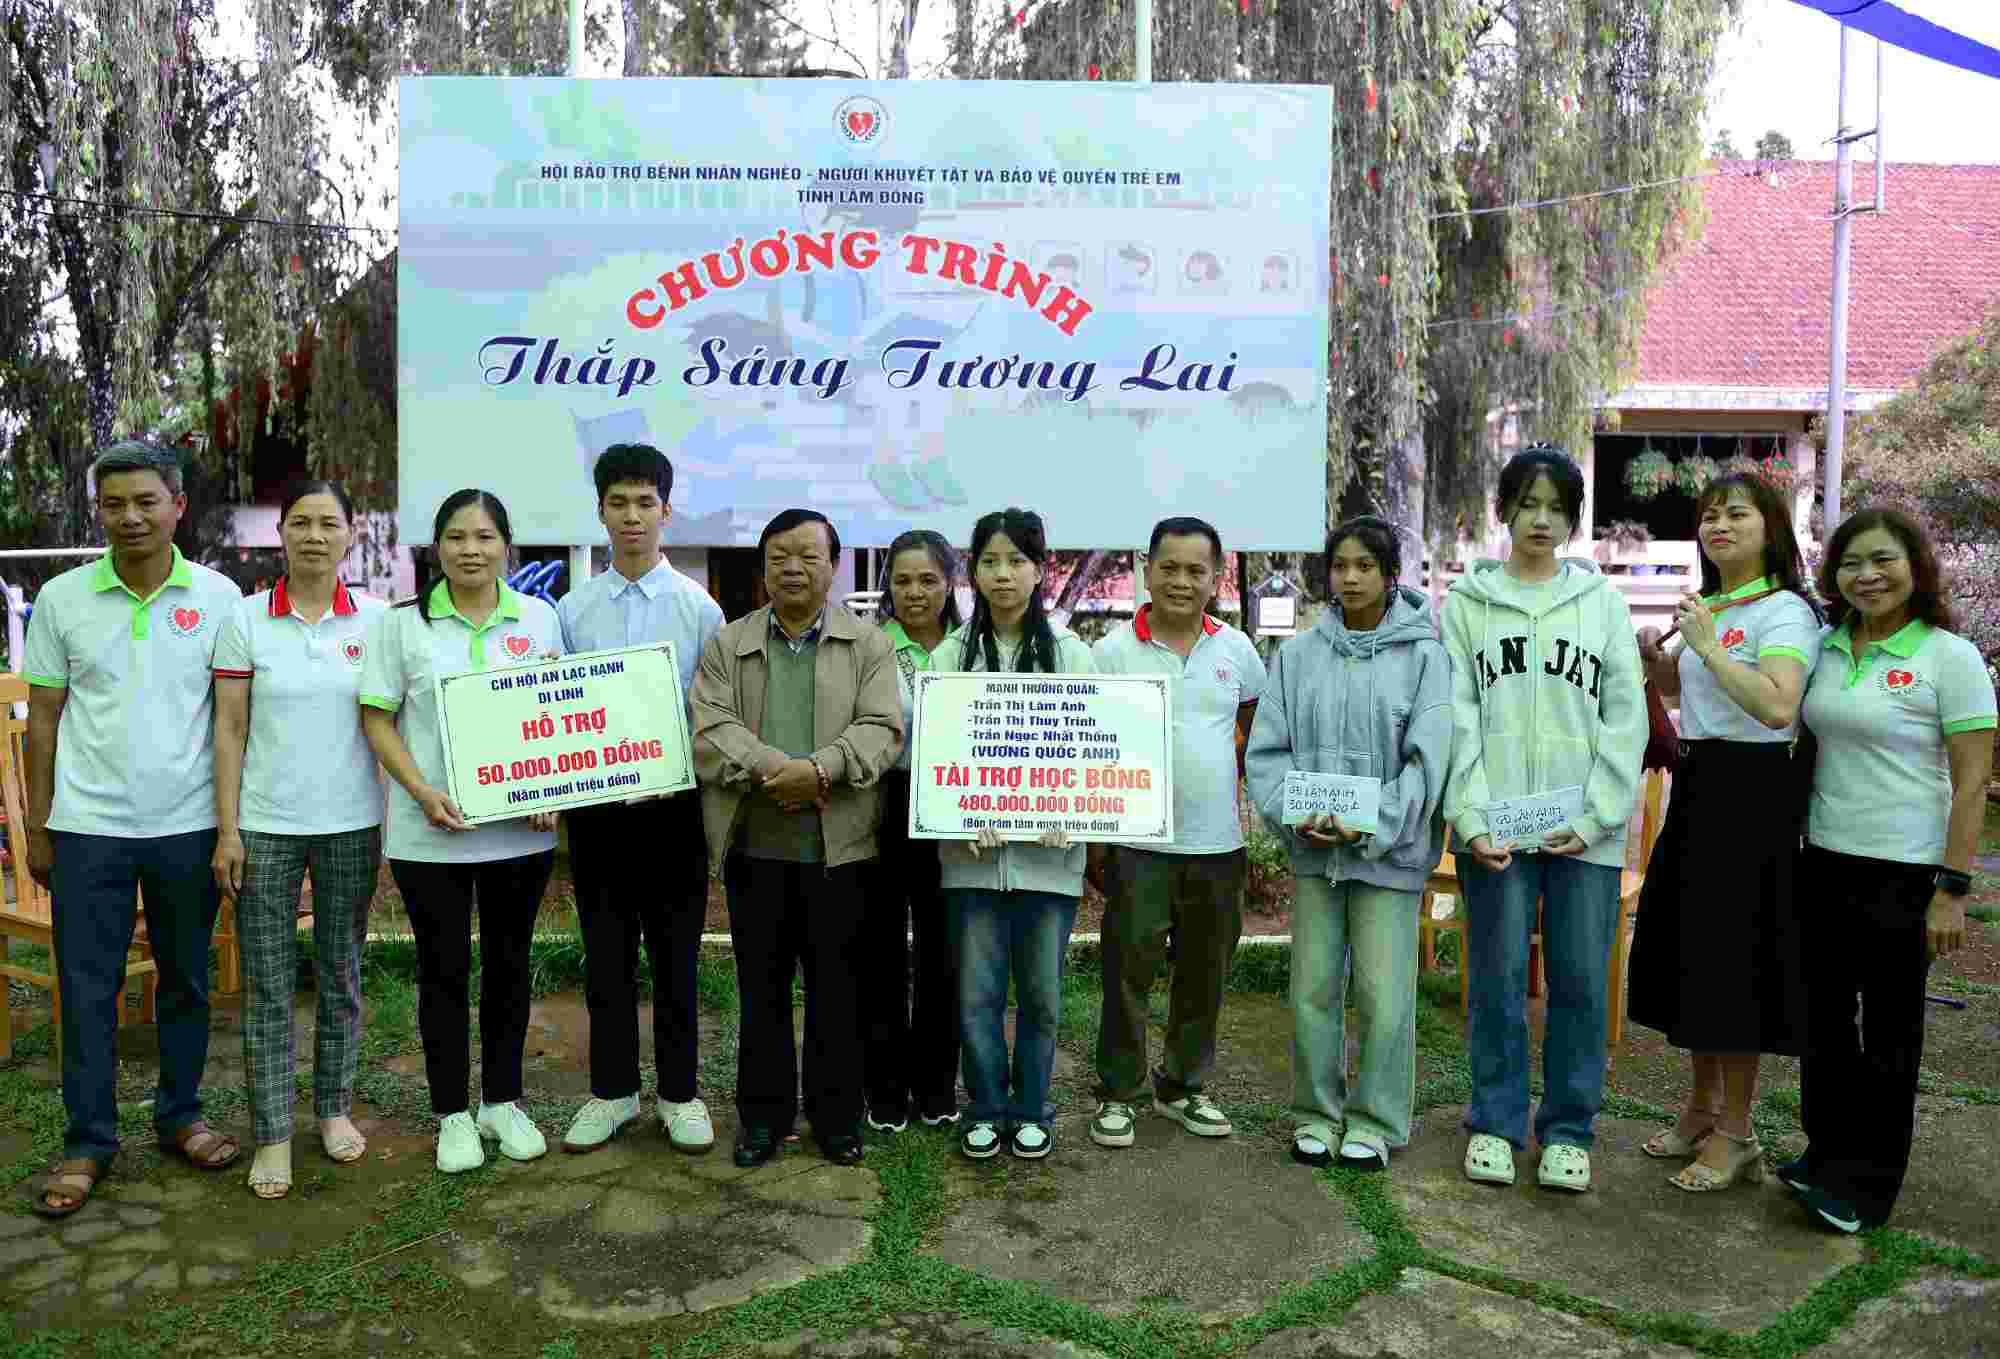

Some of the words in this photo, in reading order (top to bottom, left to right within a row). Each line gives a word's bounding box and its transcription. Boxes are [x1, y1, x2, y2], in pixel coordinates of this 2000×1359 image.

[1156, 171, 1181, 185] EM
[625, 229, 880, 329] CHƯƠNG
[902, 234, 1093, 337] TRÌNH
[479, 336, 660, 398] Thắp
[683, 337, 854, 399] Sáng
[882, 338, 1101, 401] Tương
[1119, 343, 1241, 392] Lai
[490, 675, 513, 691] CHI
[542, 670, 560, 683] AN
[538, 690, 551, 705] DI
[555, 687, 584, 702] LINH
[1061, 701, 1086, 713] Anh
[561, 707, 607, 735] TRỢ
[477, 749, 598, 786] 50.000.000
[933, 762, 969, 786] TÀI
[977, 765, 1022, 794] TRỢ
[1029, 766, 1077, 793] HỌC
[957, 794, 1069, 813] 480.000.000
